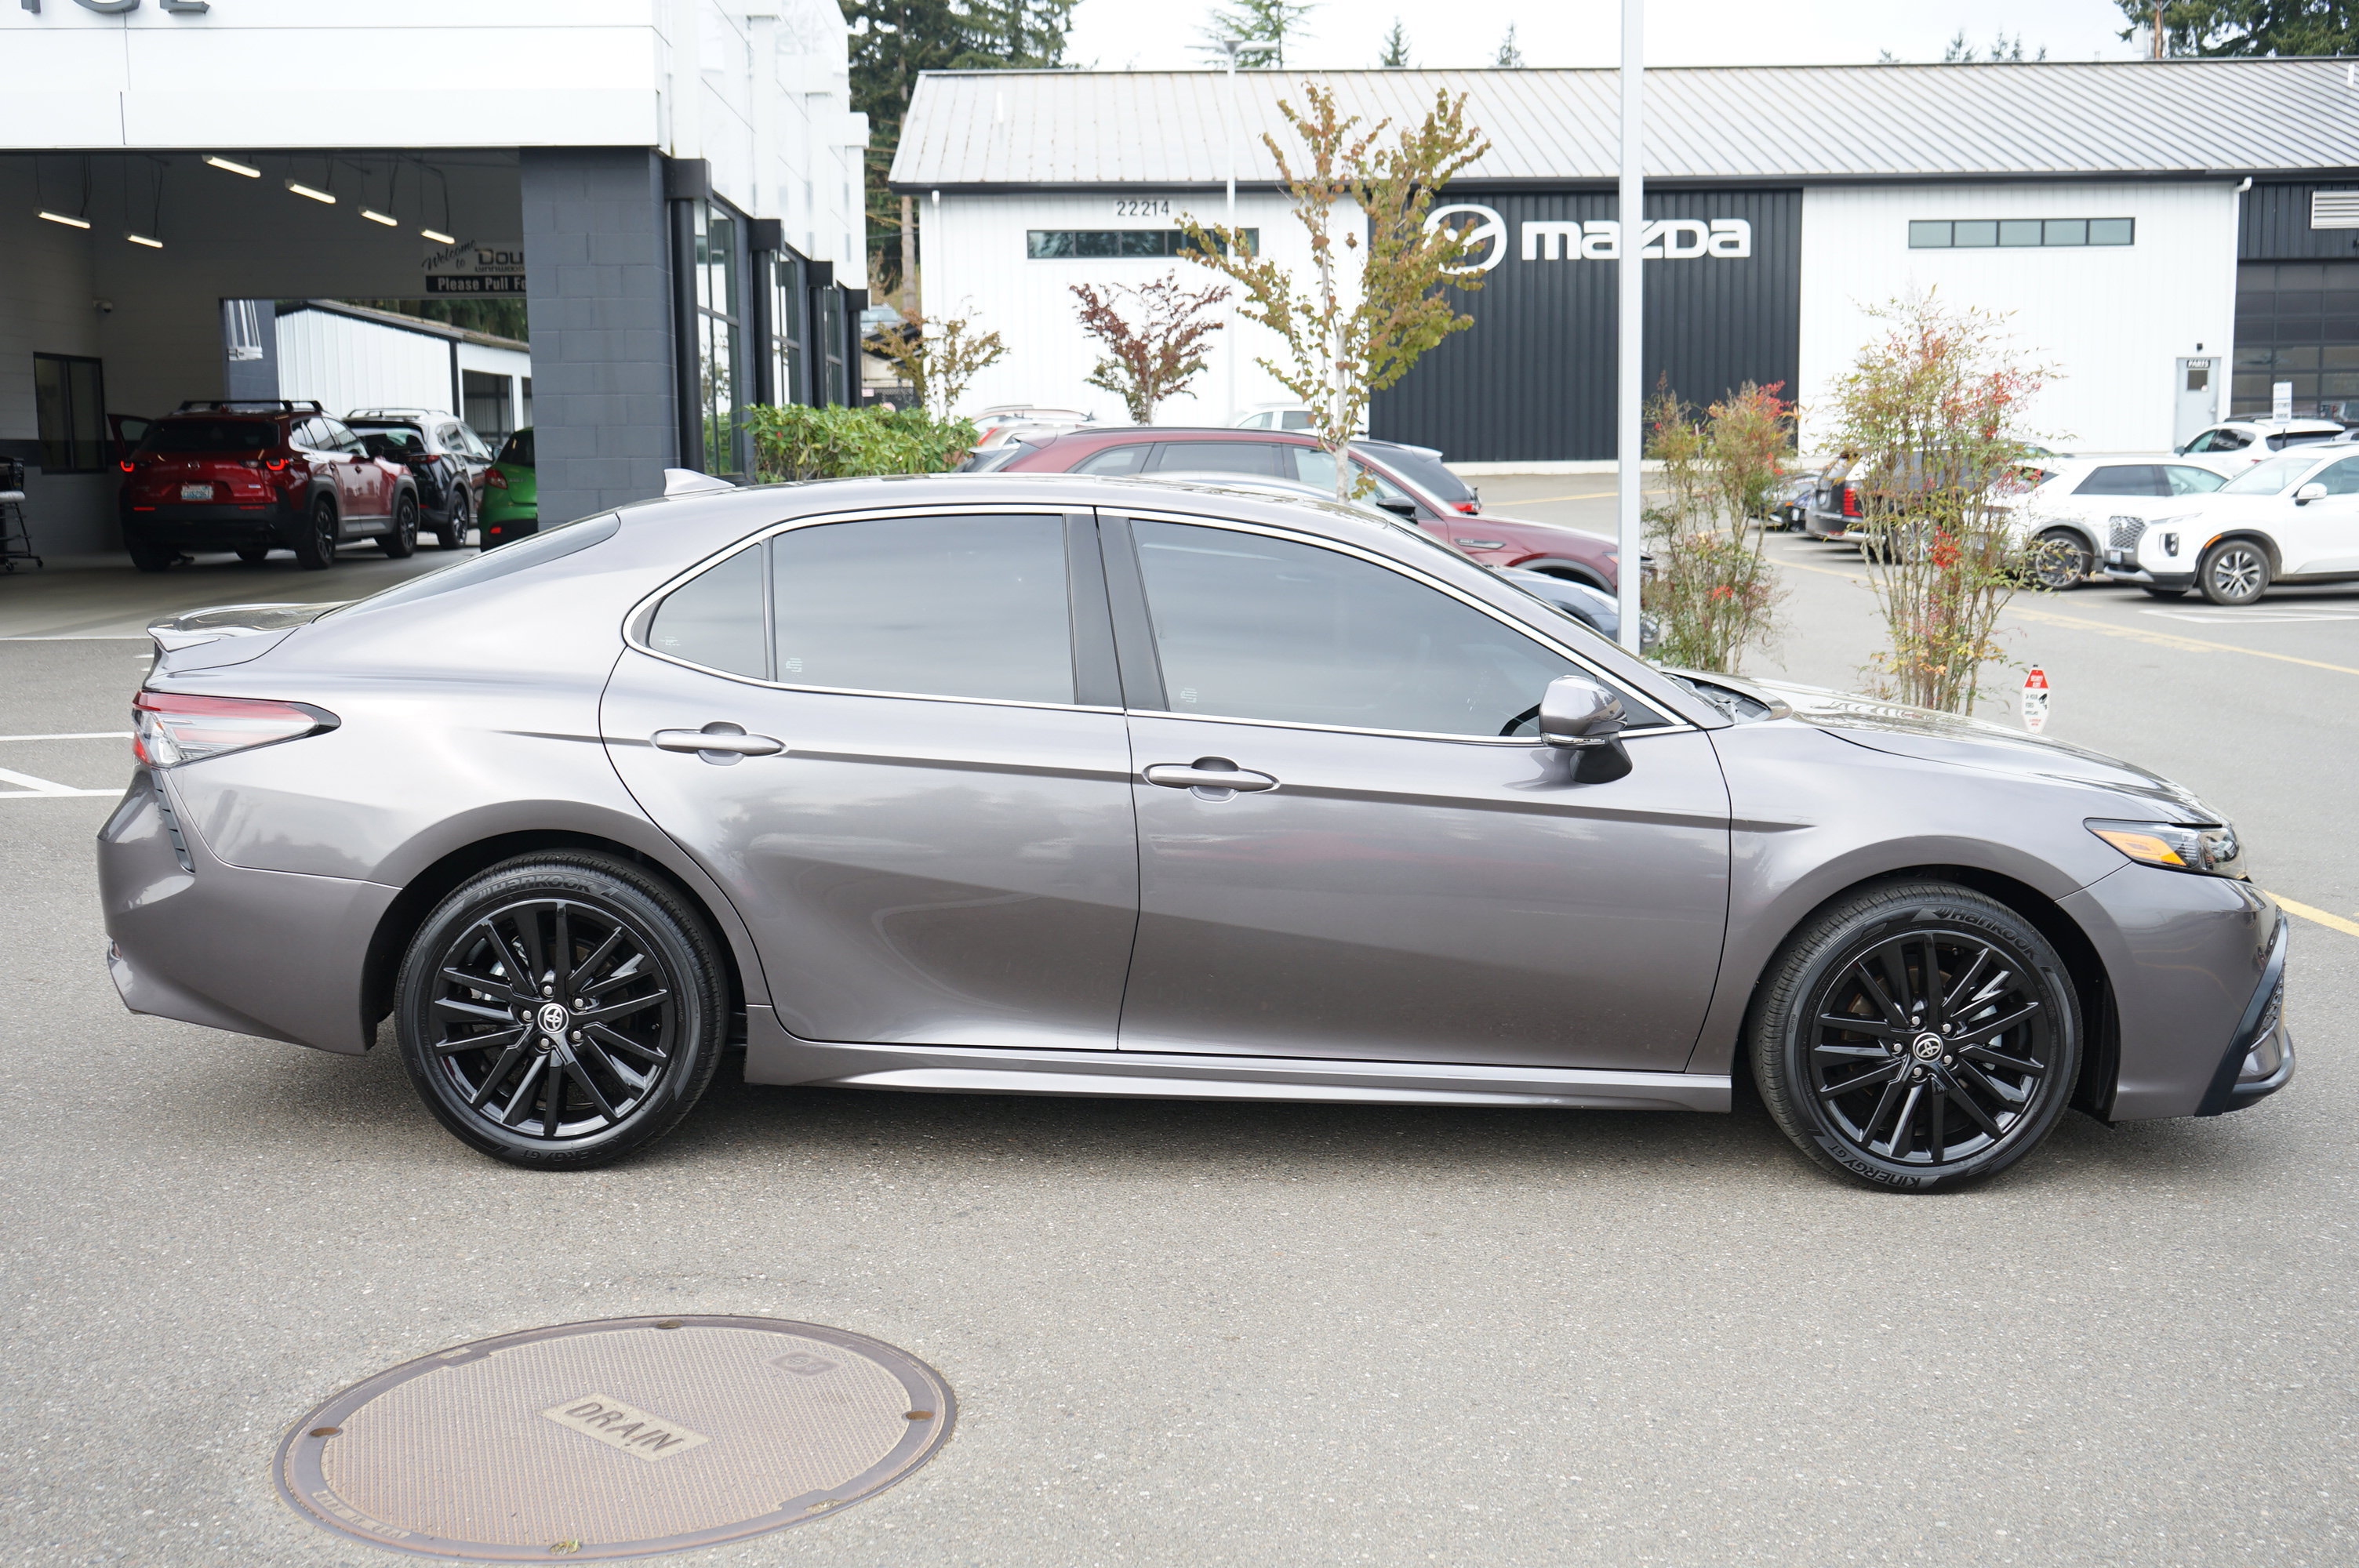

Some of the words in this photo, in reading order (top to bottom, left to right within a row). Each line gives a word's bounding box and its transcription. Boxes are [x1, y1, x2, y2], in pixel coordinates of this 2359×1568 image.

[1117, 200, 1169, 216] 22214
[421, 239, 476, 270] Welcome
[456, 258, 466, 269] to
[438, 277, 479, 291] Please
[485, 277, 509, 291] Pull
[1828, 1145, 1848, 1158] GT
[1843, 1159, 1921, 1189] KINERGY
[564, 1402, 685, 1451] DRAIN
